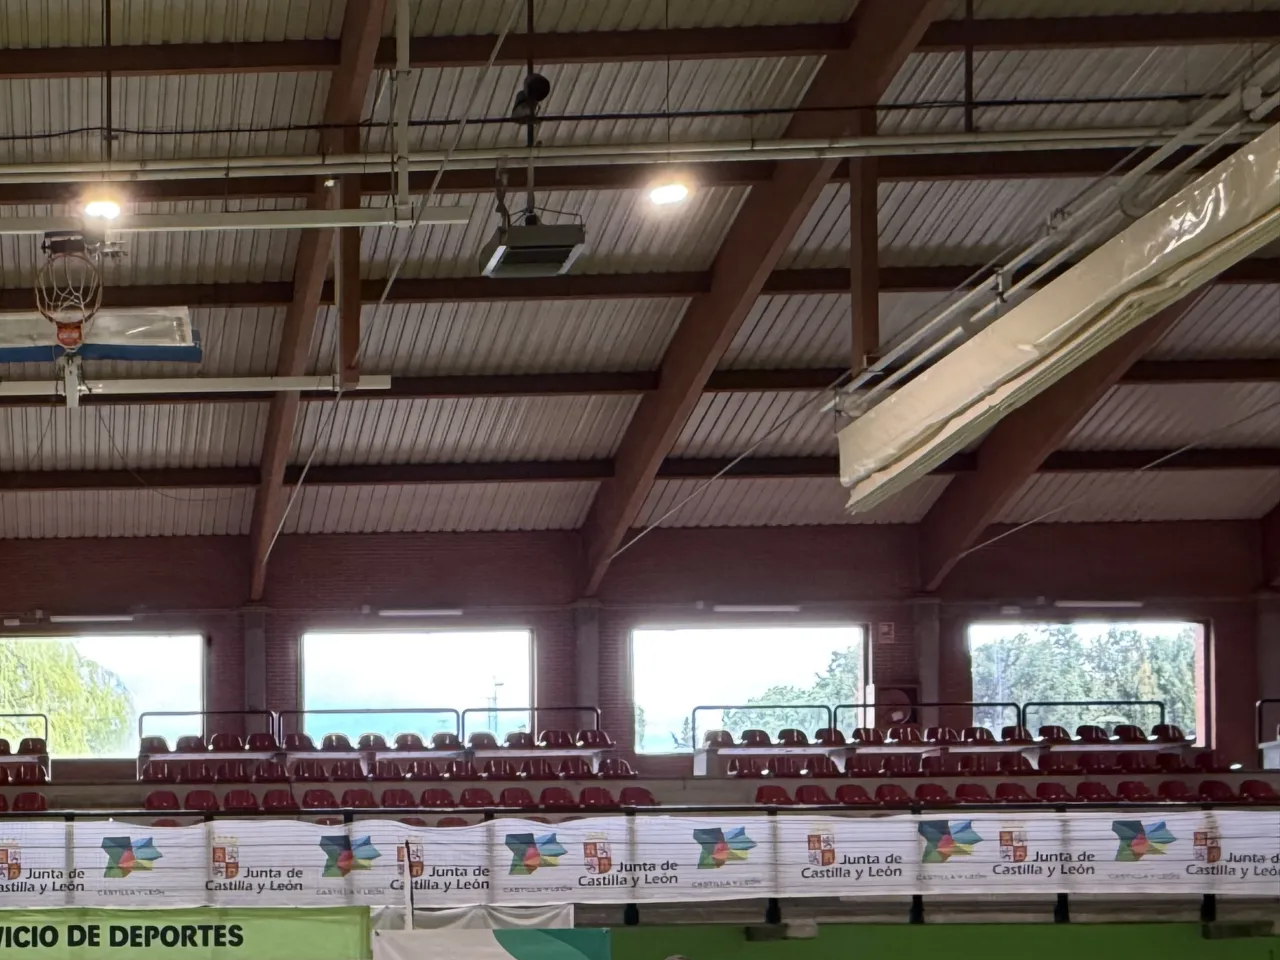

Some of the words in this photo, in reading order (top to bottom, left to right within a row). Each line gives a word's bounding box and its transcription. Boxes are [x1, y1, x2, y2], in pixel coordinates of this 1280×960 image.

[839, 854, 879, 865] Junta
[885, 854, 902, 864] de
[1032, 852, 1071, 863] Junta
[1078, 852, 1095, 862] de
[1226, 852, 1266, 863] Junta
[243, 868, 282, 878] Junta
[286, 868, 303, 878] de
[429, 866, 468, 877] Junta
[473, 866, 490, 877] de
[616, 862, 656, 873] Junta
[662, 860, 679, 871] de
[801, 868, 851, 879] Castilla
[855, 870, 864, 881] y
[869, 866, 902, 877] León
[992, 864, 1042, 876] Castilla
[1047, 866, 1056, 878] y
[1061, 864, 1095, 875] León
[1186, 864, 1236, 876] Castilla
[1240, 868, 1249, 880] y
[1254, 866, 1280, 876] Leó
[25, 868, 63, 880] Junta
[68, 868, 85, 879] de
[578, 876, 628, 887] Castilla
[632, 878, 640, 887] y
[645, 873, 679, 885] León
[39, 884, 47, 895] y
[52, 880, 85, 892] León
[205, 880, 253, 891] Castilla
[257, 882, 265, 894] y
[270, 879, 303, 891] León
[390, 879, 439, 890] Catilla
[444, 882, 452, 893] y
[456, 878, 490, 890] León
[68, 924, 100, 947] DE
[109, 924, 244, 947] DEPORTES
